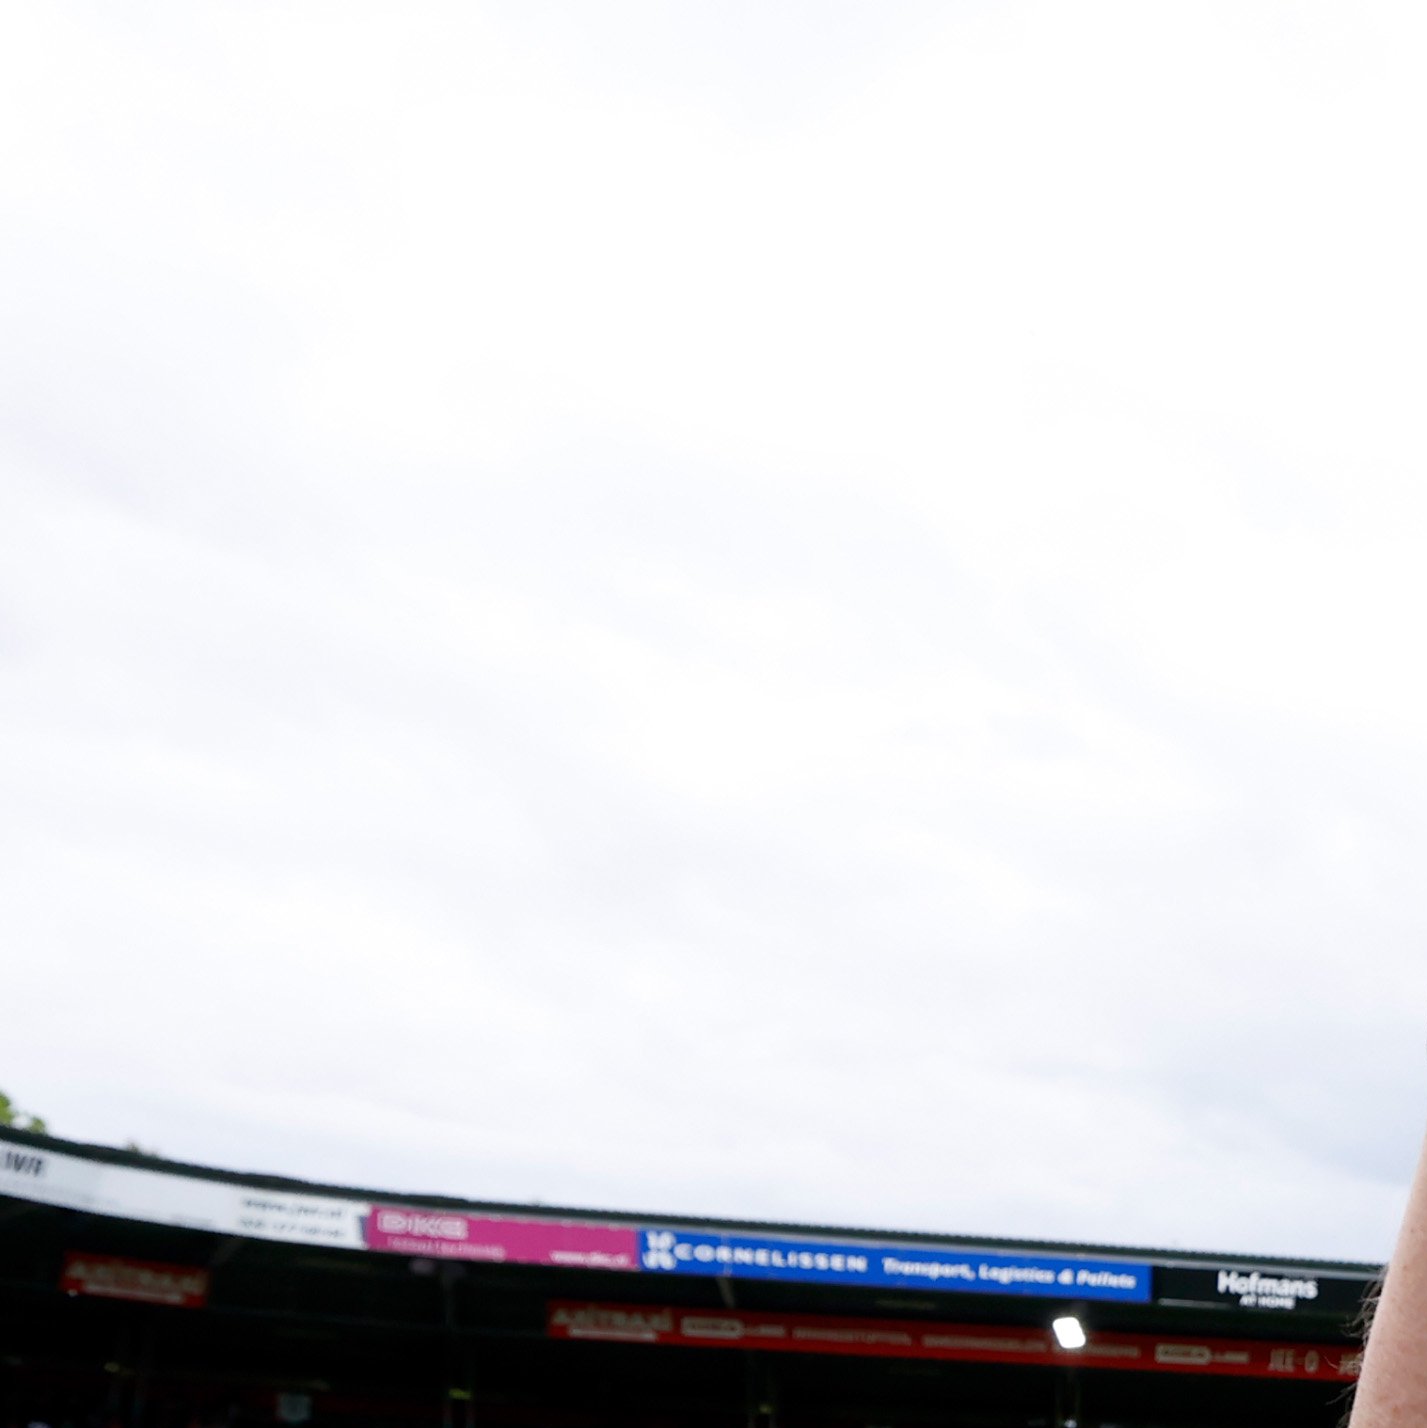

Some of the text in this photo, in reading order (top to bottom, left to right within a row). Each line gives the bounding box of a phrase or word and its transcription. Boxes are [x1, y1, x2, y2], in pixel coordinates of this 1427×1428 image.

[673, 1242, 868, 1274] CORNELISSEN
[881, 1256, 1138, 1289] Transport, Logistics & Pallets
[1217, 1269, 1319, 1300] Hofmans
